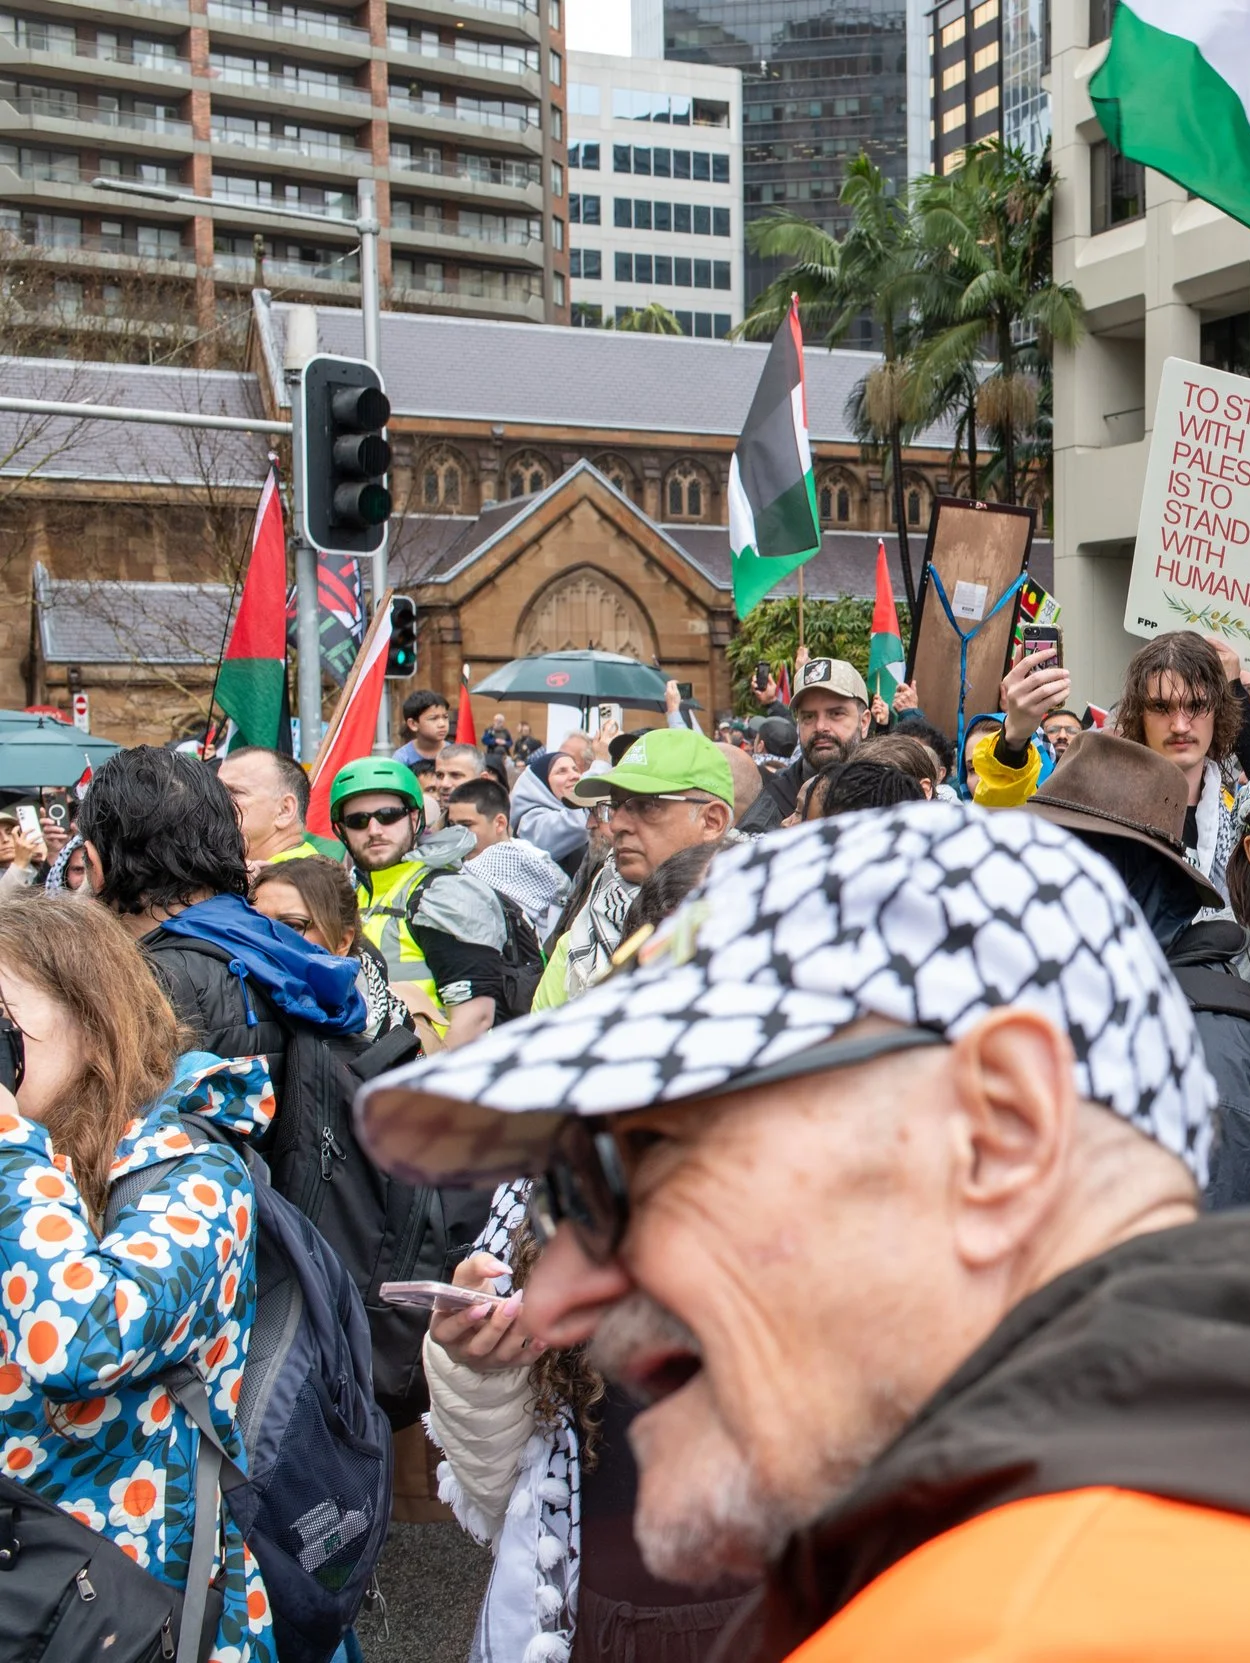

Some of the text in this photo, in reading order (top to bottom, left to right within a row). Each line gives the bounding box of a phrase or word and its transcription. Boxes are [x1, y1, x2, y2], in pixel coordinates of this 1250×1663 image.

[1183, 381, 1220, 414] TO
[1179, 411, 1246, 454] WITH
[1168, 470, 1233, 510] IS TO
[1164, 499, 1250, 545] STAND
[1161, 527, 1226, 569] WITH
[1137, 616, 1158, 629] FPP
